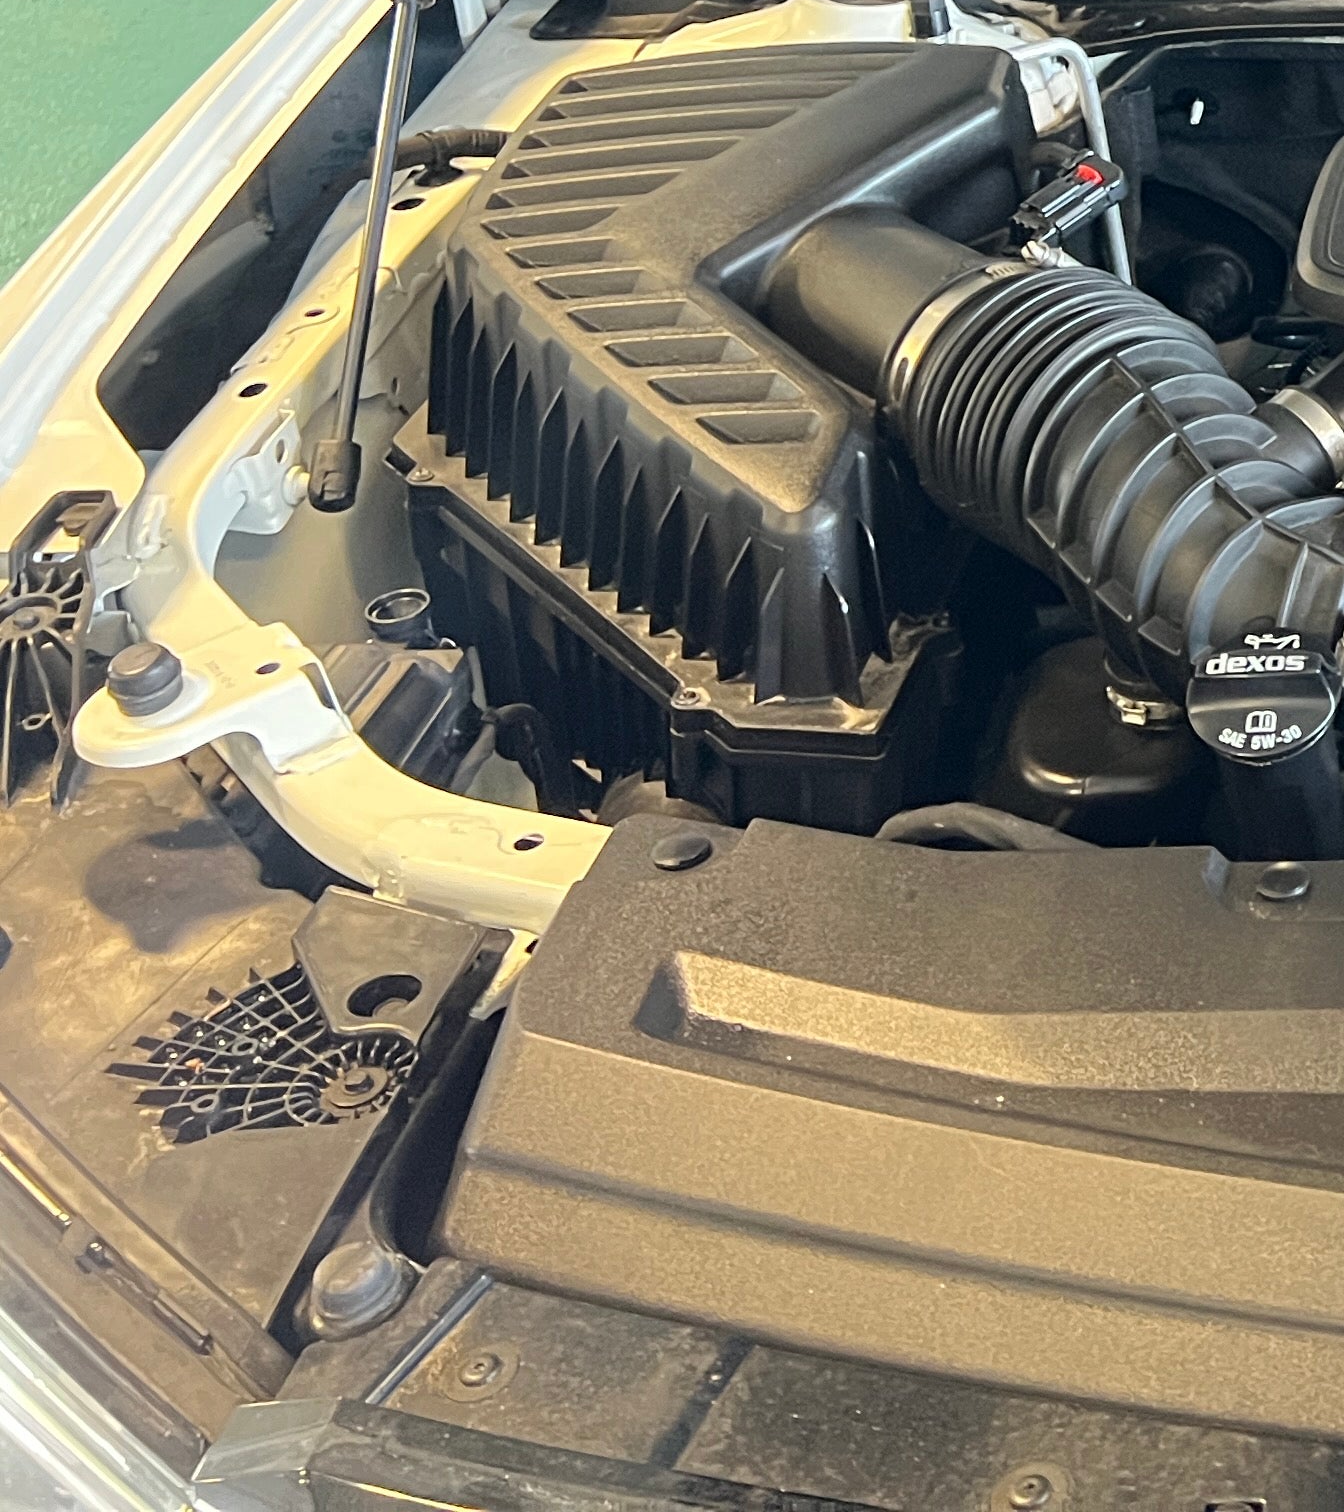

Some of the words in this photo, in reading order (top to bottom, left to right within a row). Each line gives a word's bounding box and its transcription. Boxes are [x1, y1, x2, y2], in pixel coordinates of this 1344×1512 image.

[1205, 653, 1306, 675] dexos
[1218, 727, 1248, 749] SAE
[1250, 724, 1302, 750] 5W-30
